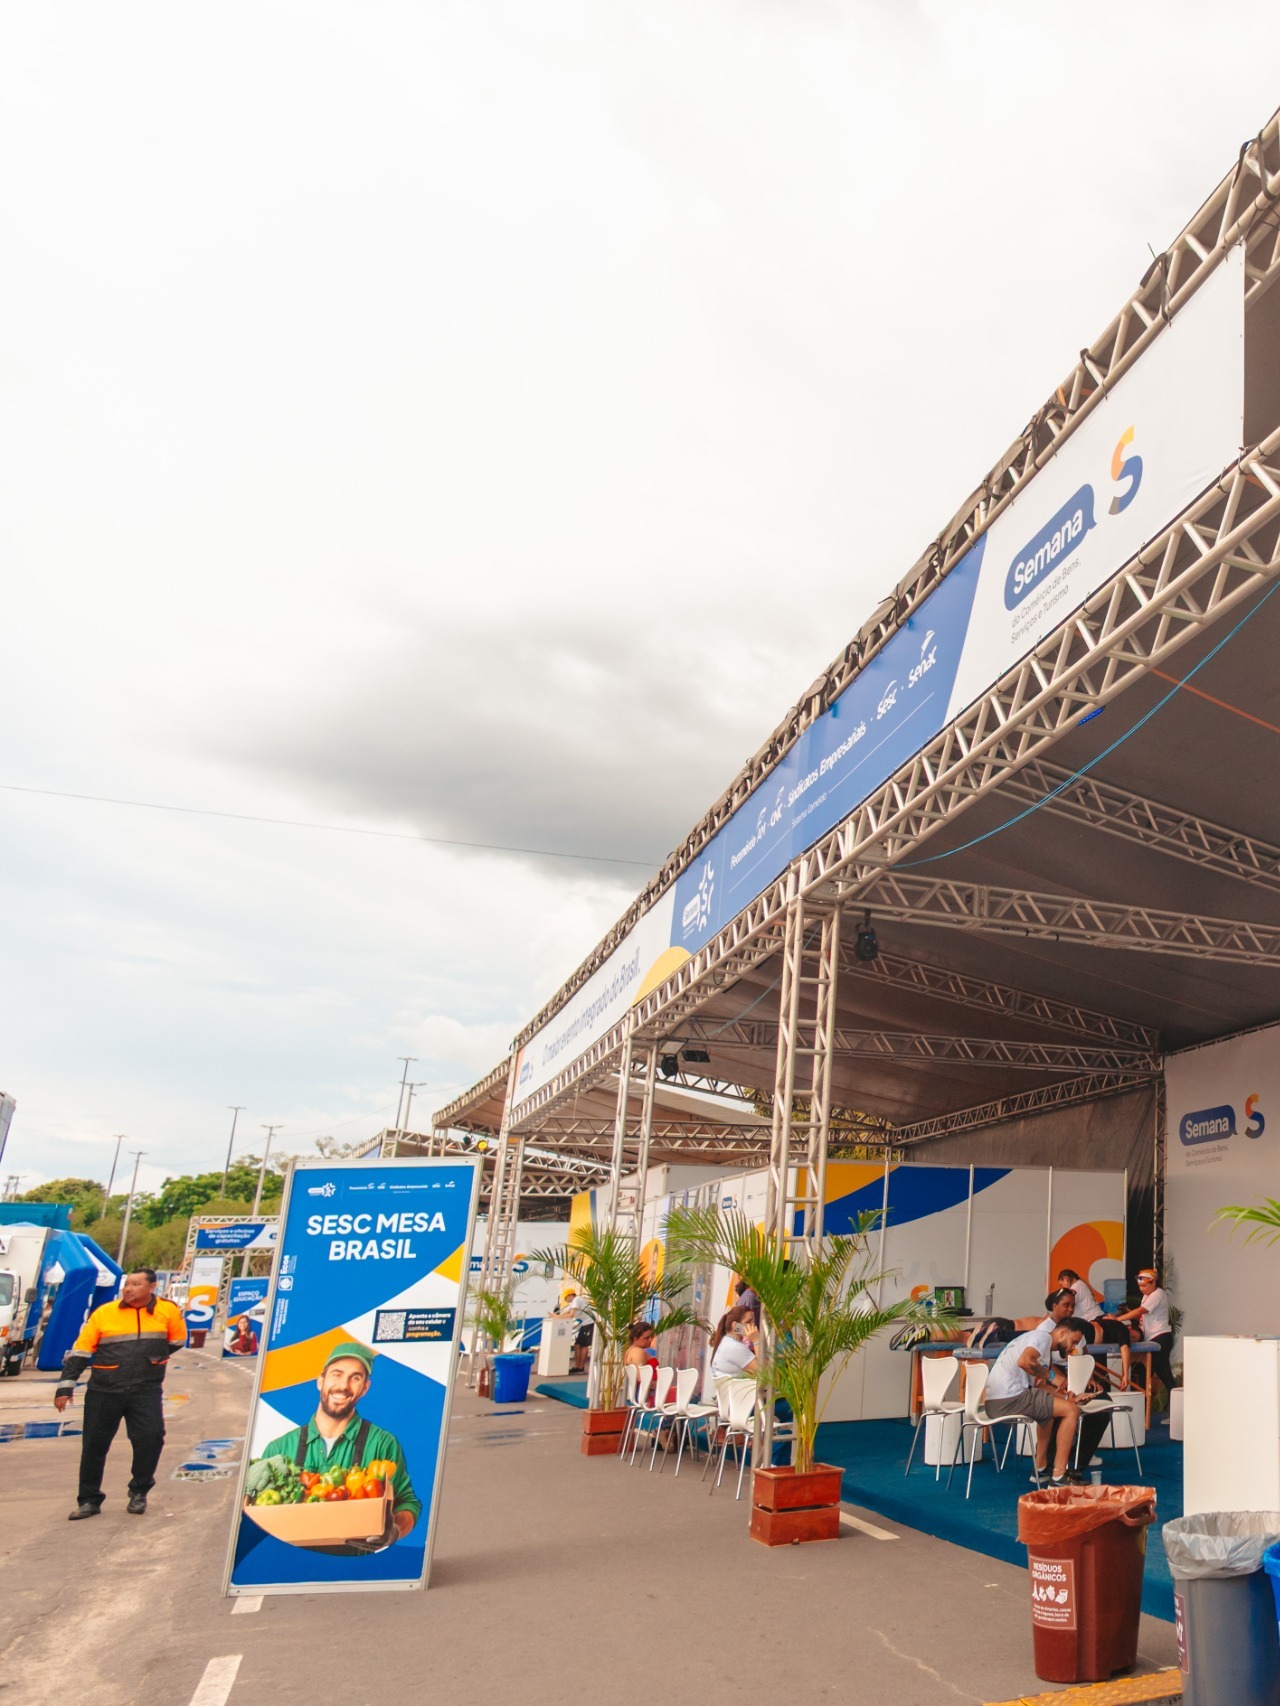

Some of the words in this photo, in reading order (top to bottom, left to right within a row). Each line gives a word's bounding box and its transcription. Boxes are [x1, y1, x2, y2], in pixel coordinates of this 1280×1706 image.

[1108, 424, 1143, 516] S
[1014, 509, 1083, 594] Semana
[1011, 613, 1020, 628] do
[1021, 584, 1052, 619] Comércio
[1052, 572, 1061, 589] de
[1011, 615, 1037, 644] Serviços
[1043, 585, 1069, 615] Turismo
[788, 768, 819, 808] Sindicatos
[819, 721, 867, 776] Empresariais
[1185, 1117, 1229, 1139] Semana
[1245, 1093, 1265, 1139] S
[306, 1213, 373, 1235] SESC
[376, 1212, 446, 1233] MESA
[328, 1239, 417, 1261] BRASIL
[186, 1294, 214, 1323] S
[1032, 1571, 1067, 1582] ORGÂNICOS
[1033, 1562, 1062, 1573] RESÍDUOS
